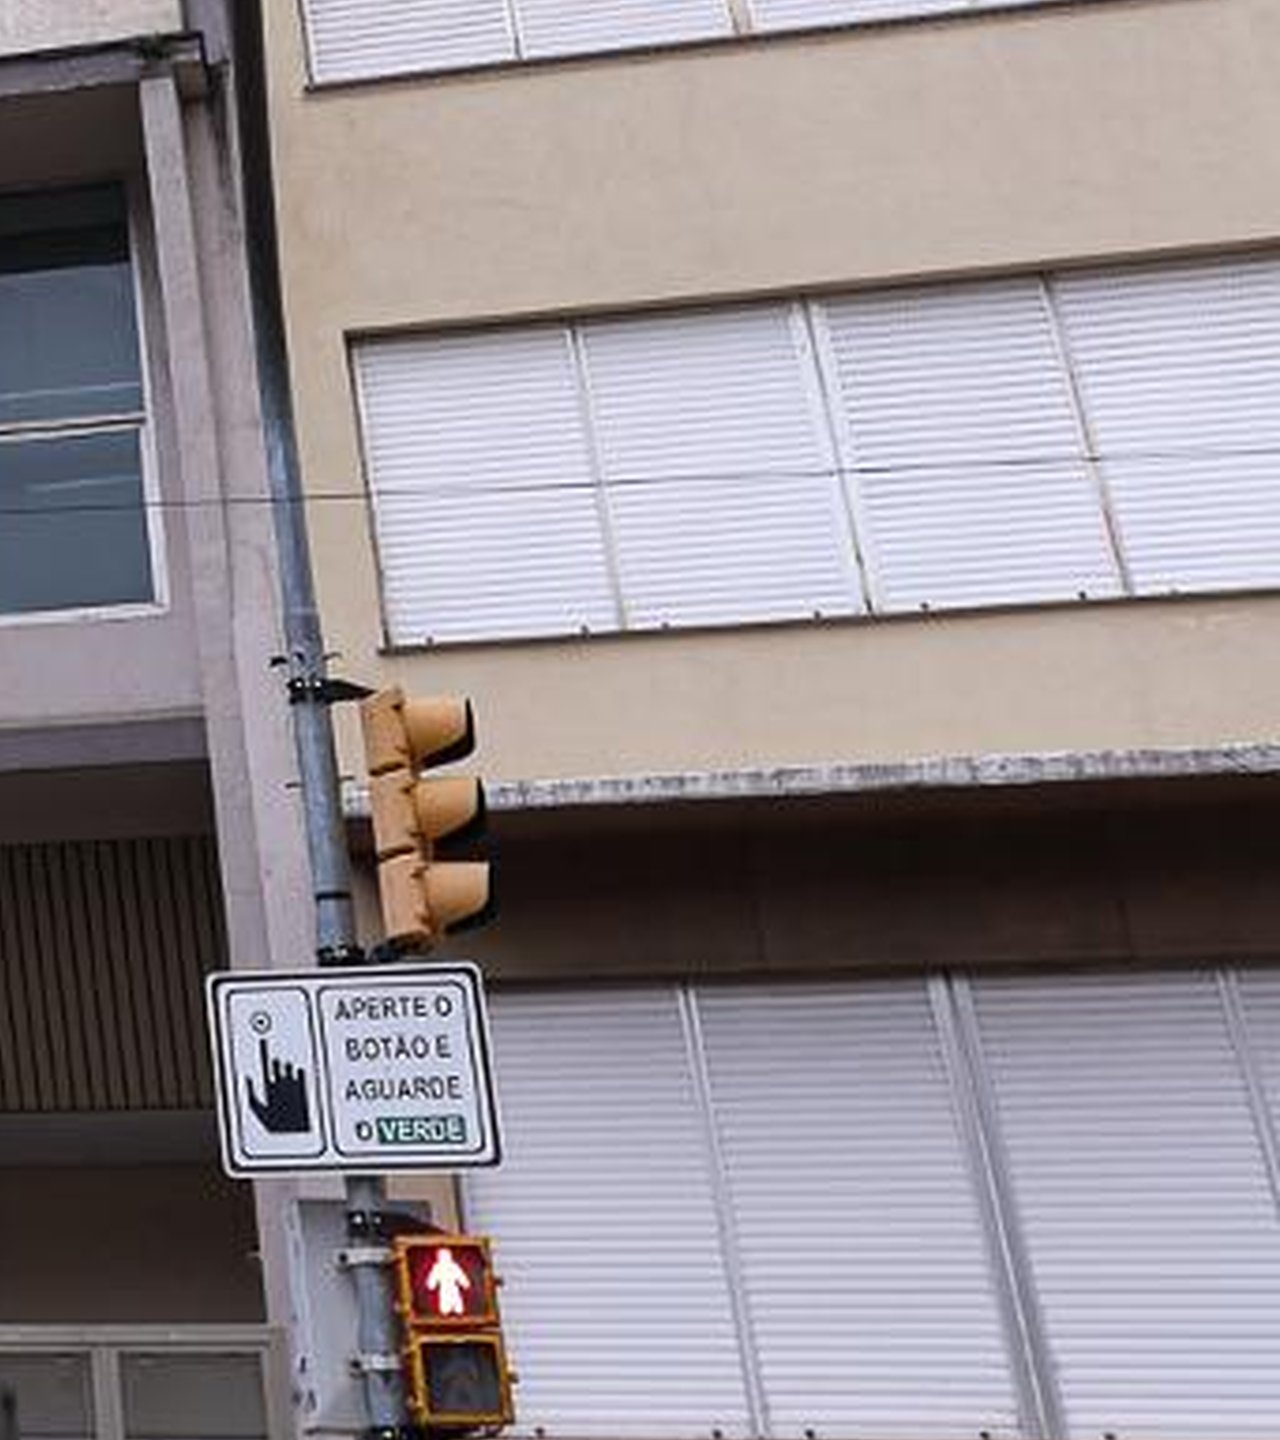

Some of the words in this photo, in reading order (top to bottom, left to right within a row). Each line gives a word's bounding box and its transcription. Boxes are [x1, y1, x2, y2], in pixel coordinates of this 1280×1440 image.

[335, 996, 427, 1020] APERTE
[435, 995, 452, 1017] O
[436, 1034, 452, 1058] E
[345, 1076, 462, 1101] AGUARDE
[356, 1120, 372, 1141] O
[379, 1118, 465, 1142] VERDE
